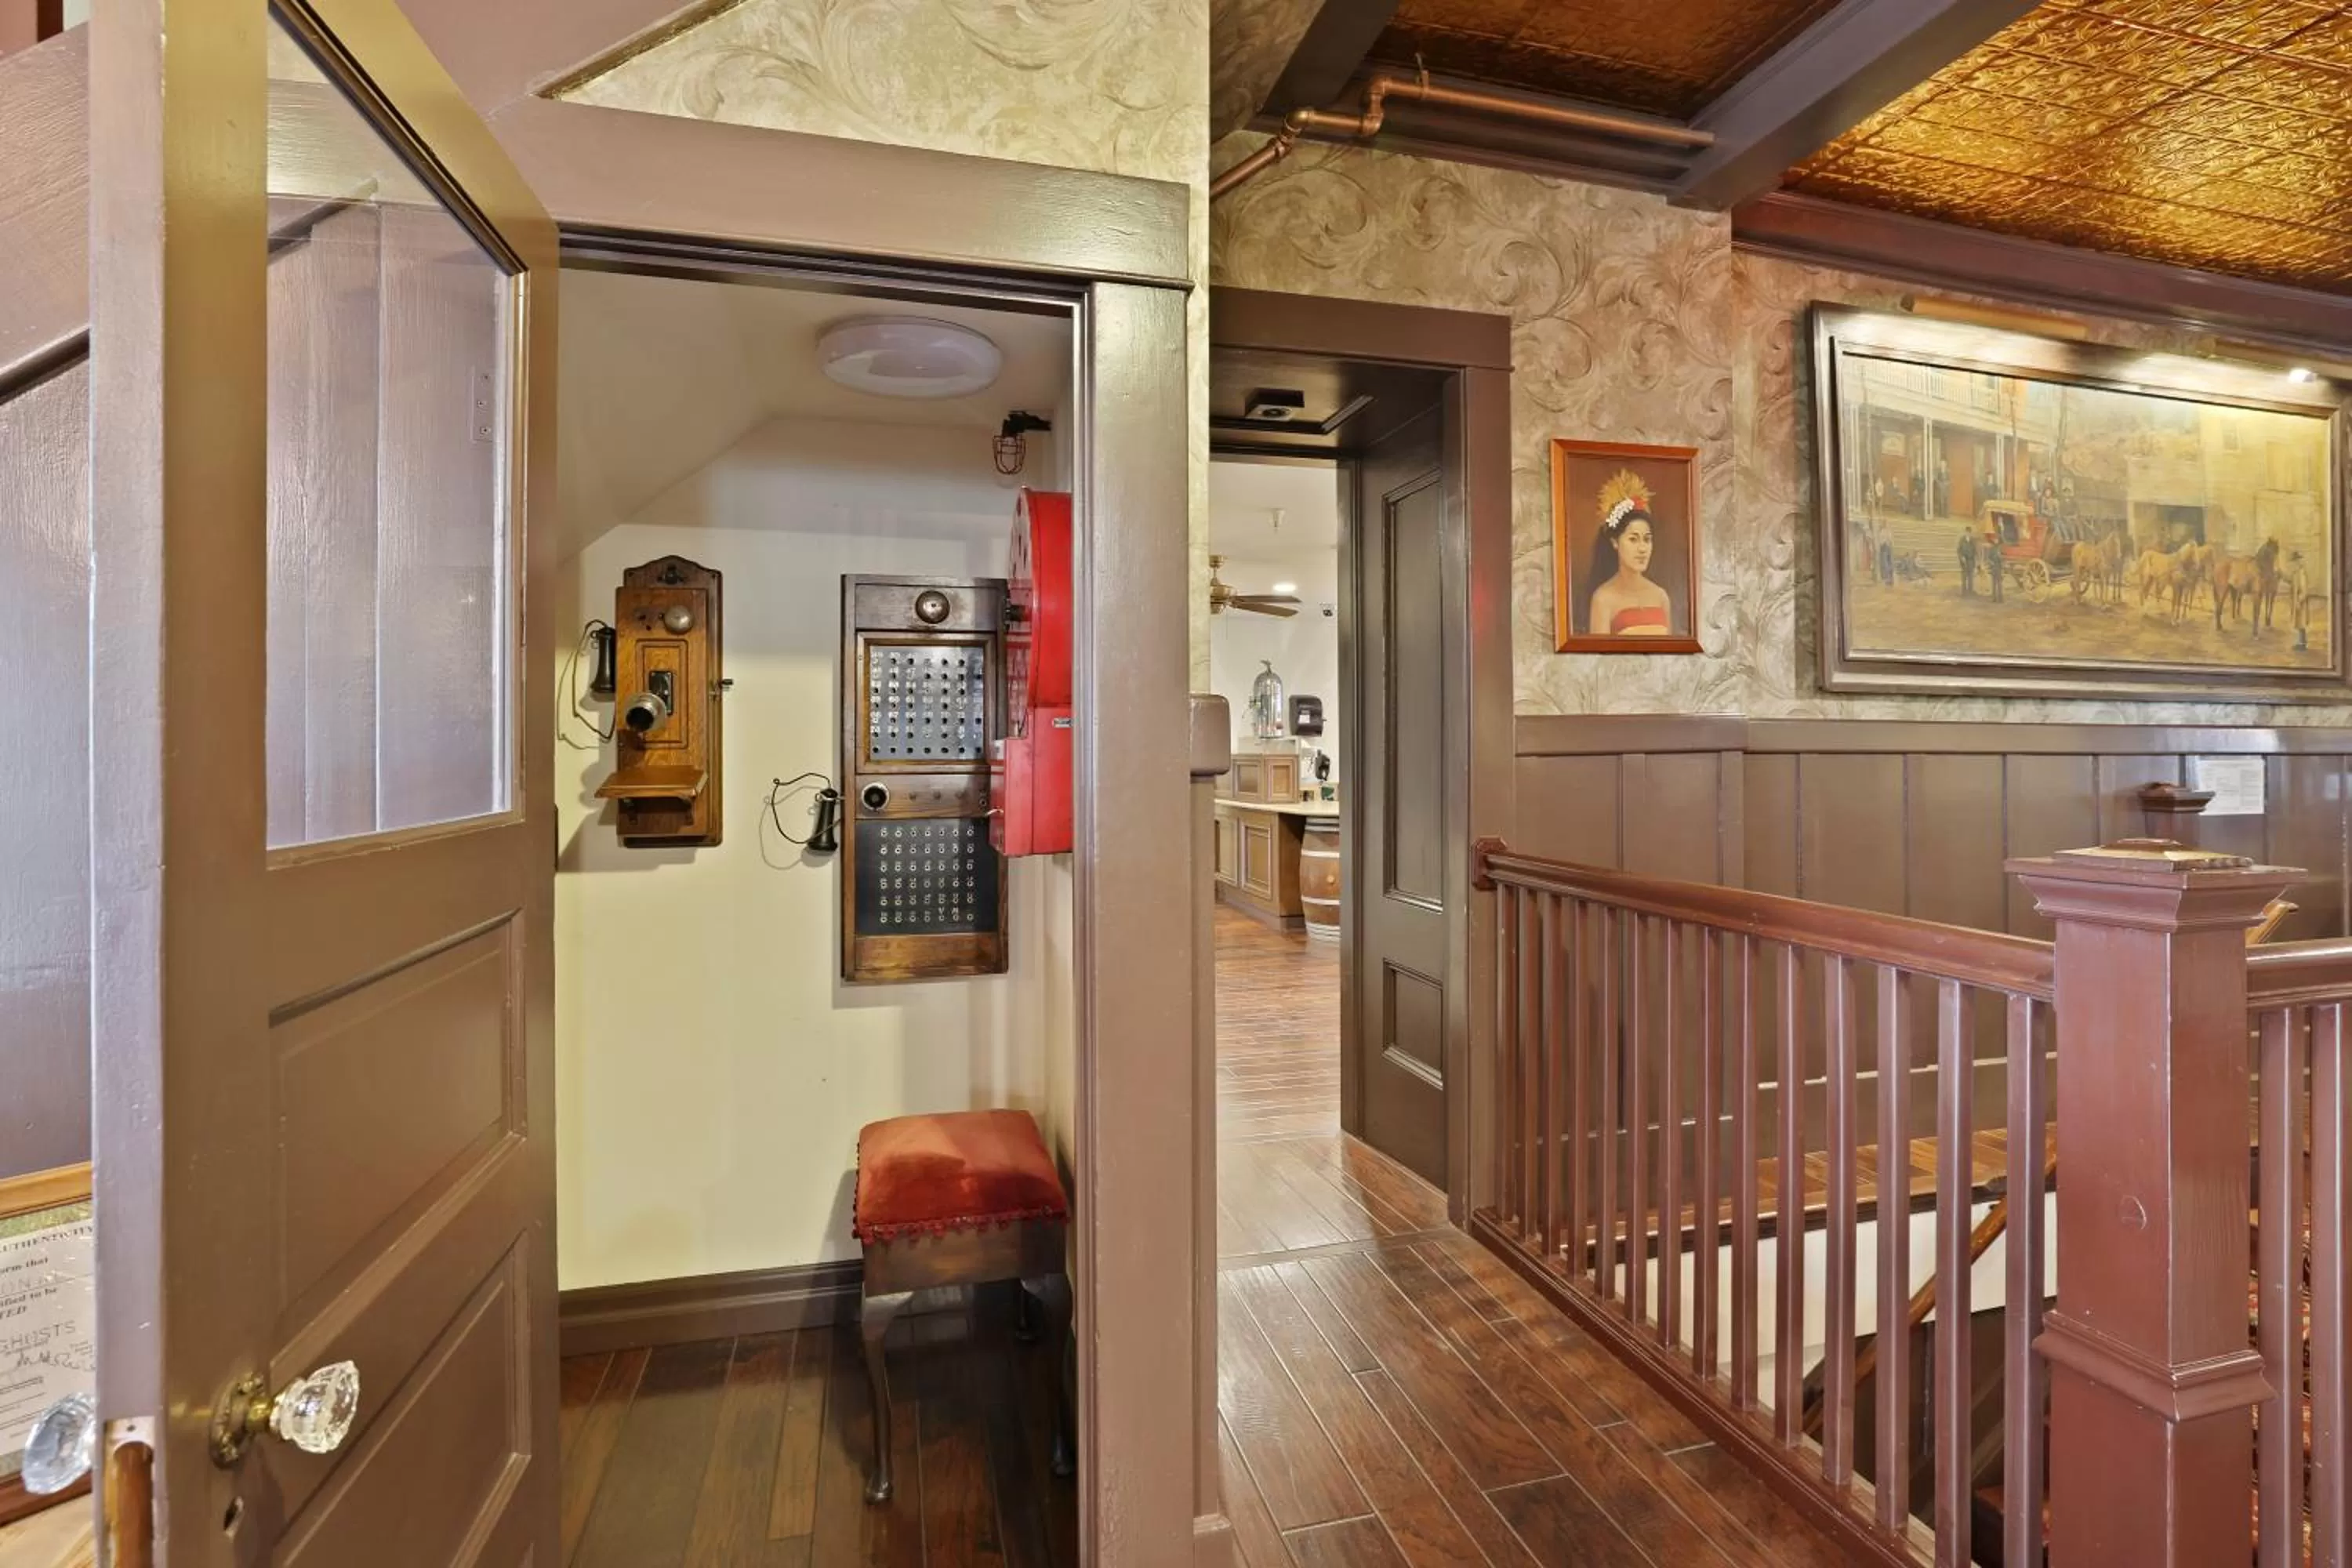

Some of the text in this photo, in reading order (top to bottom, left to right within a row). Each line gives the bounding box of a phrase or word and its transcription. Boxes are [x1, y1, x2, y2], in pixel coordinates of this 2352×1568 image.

[26, 1257, 48, 1268] that
[30, 1290, 42, 1300] to
[45, 1287, 57, 1296] be
